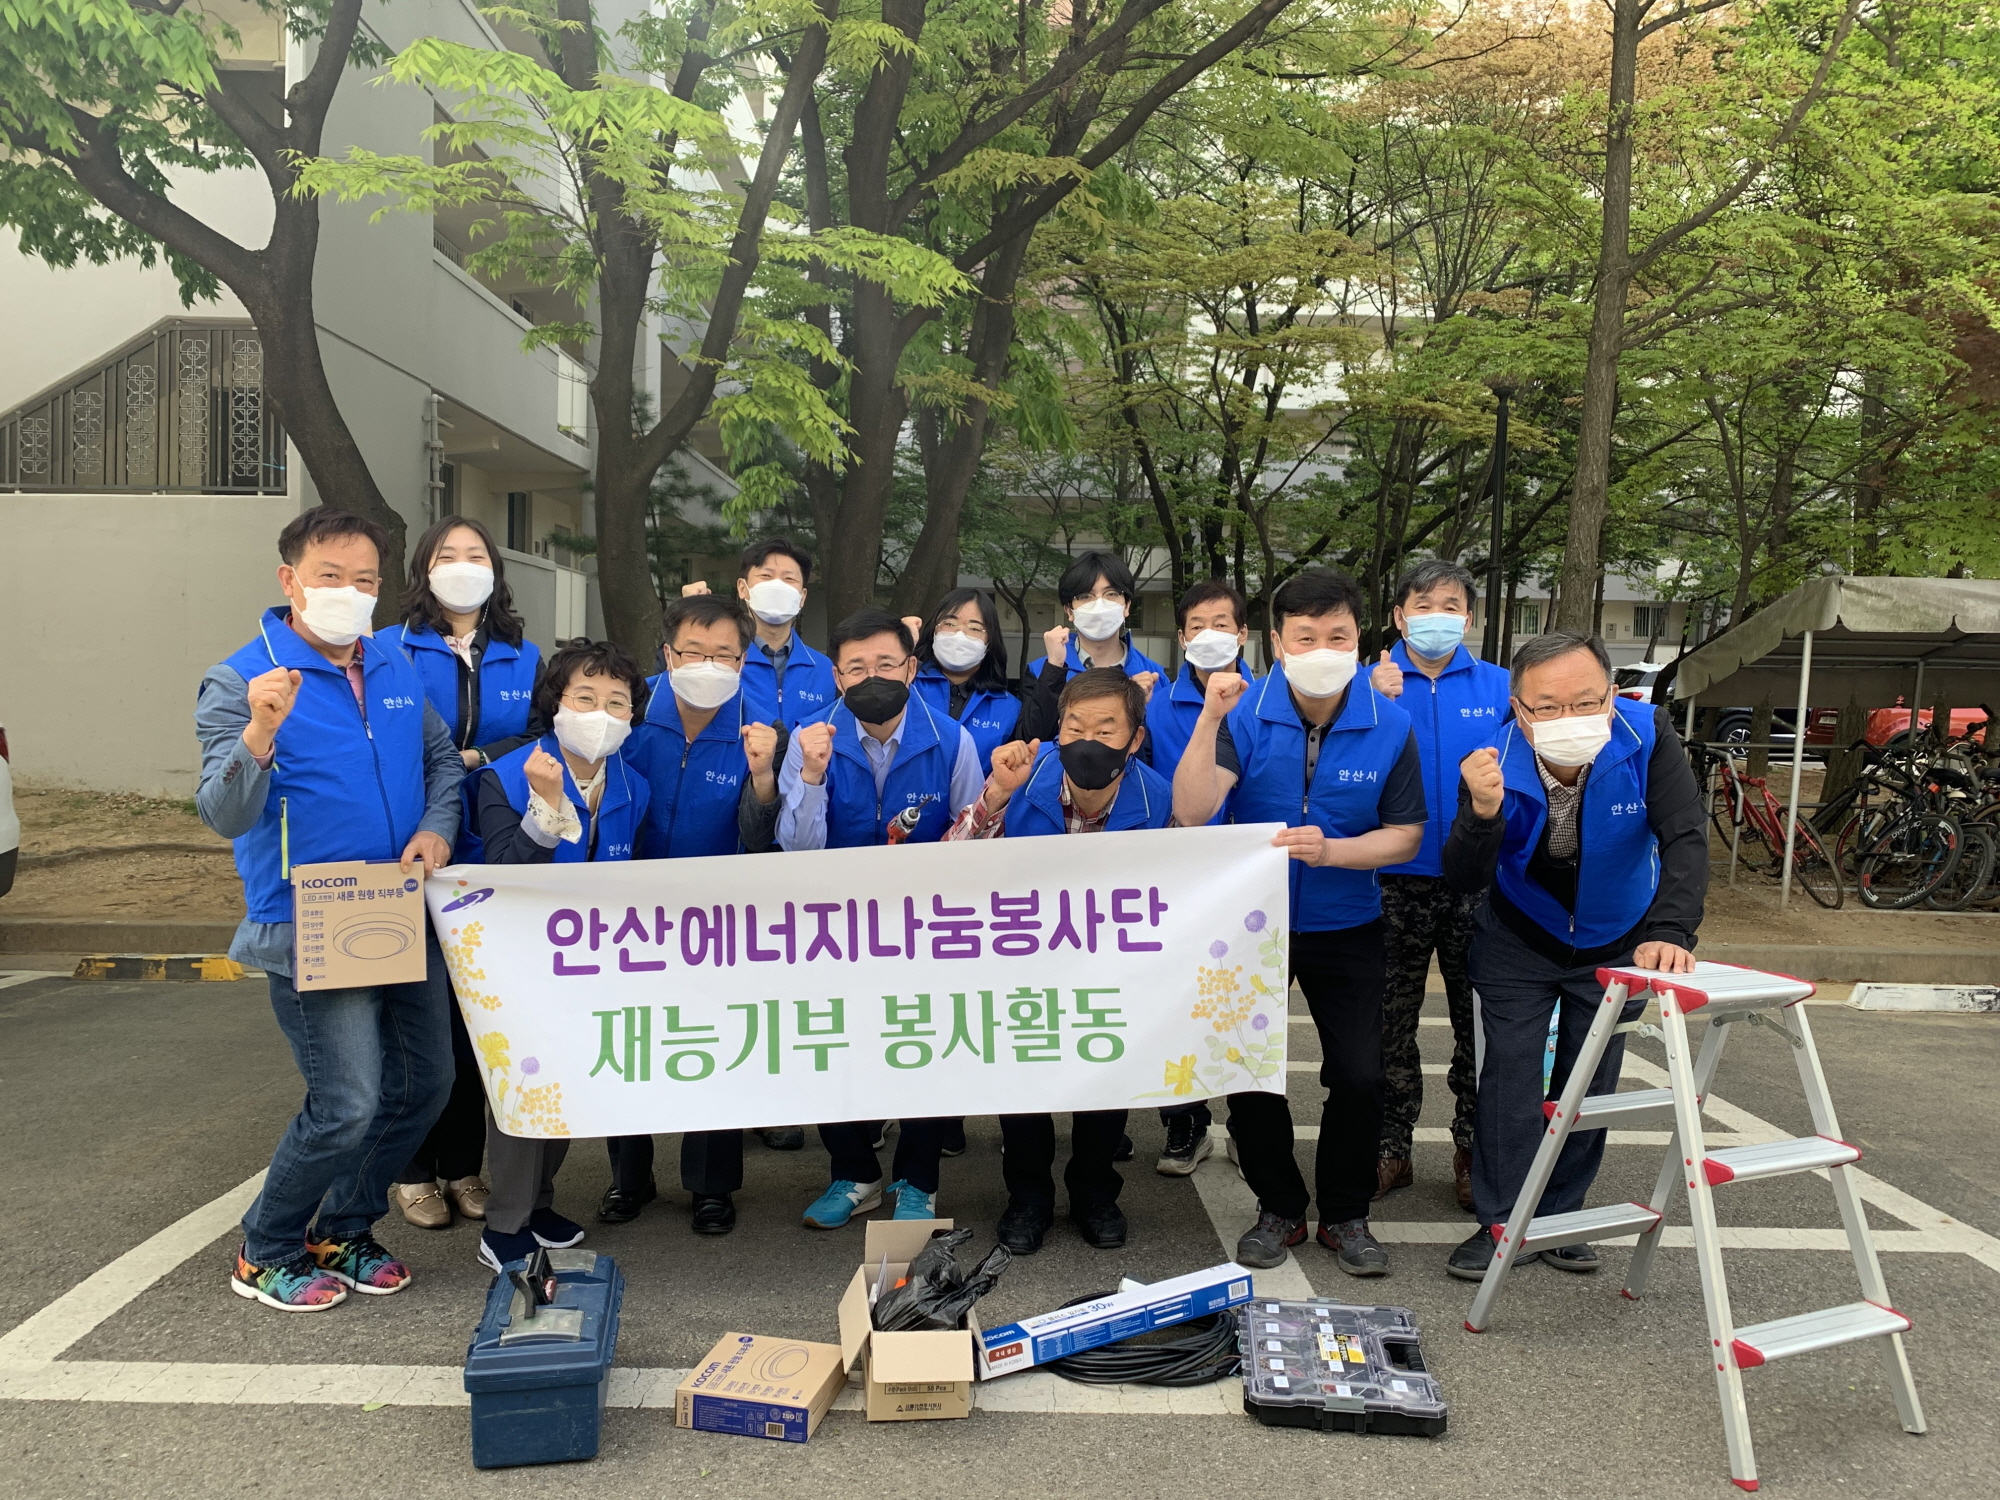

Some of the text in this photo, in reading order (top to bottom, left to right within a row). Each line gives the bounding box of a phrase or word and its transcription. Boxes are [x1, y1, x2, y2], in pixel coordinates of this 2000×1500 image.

[499, 689, 531, 701] 안산시
[799, 690, 824, 702] 안산시
[382, 696, 414, 709] 안산시
[1460, 706, 1495, 718] 안산시
[972, 717, 1000, 730] 안산시
[705, 770, 738, 786] 안산시
[1338, 769, 1377, 783] 안산시
[906, 791, 941, 804] 안산시
[608, 843, 631, 857] 안산시
[302, 877, 358, 889] KOCOM
[337, 891, 355, 902] 새론
[357, 889, 375, 900] 원형
[378, 888, 405, 899] 직부등
[546, 886, 1169, 976] 안산에너지나눔봉사단
[588, 986, 1128, 1083] 재능기부 봉사활동
[1087, 1301, 1115, 1313] 30W
[1009, 1357, 1023, 1366] KOREA
[782, 1412, 795, 1421] ISO
